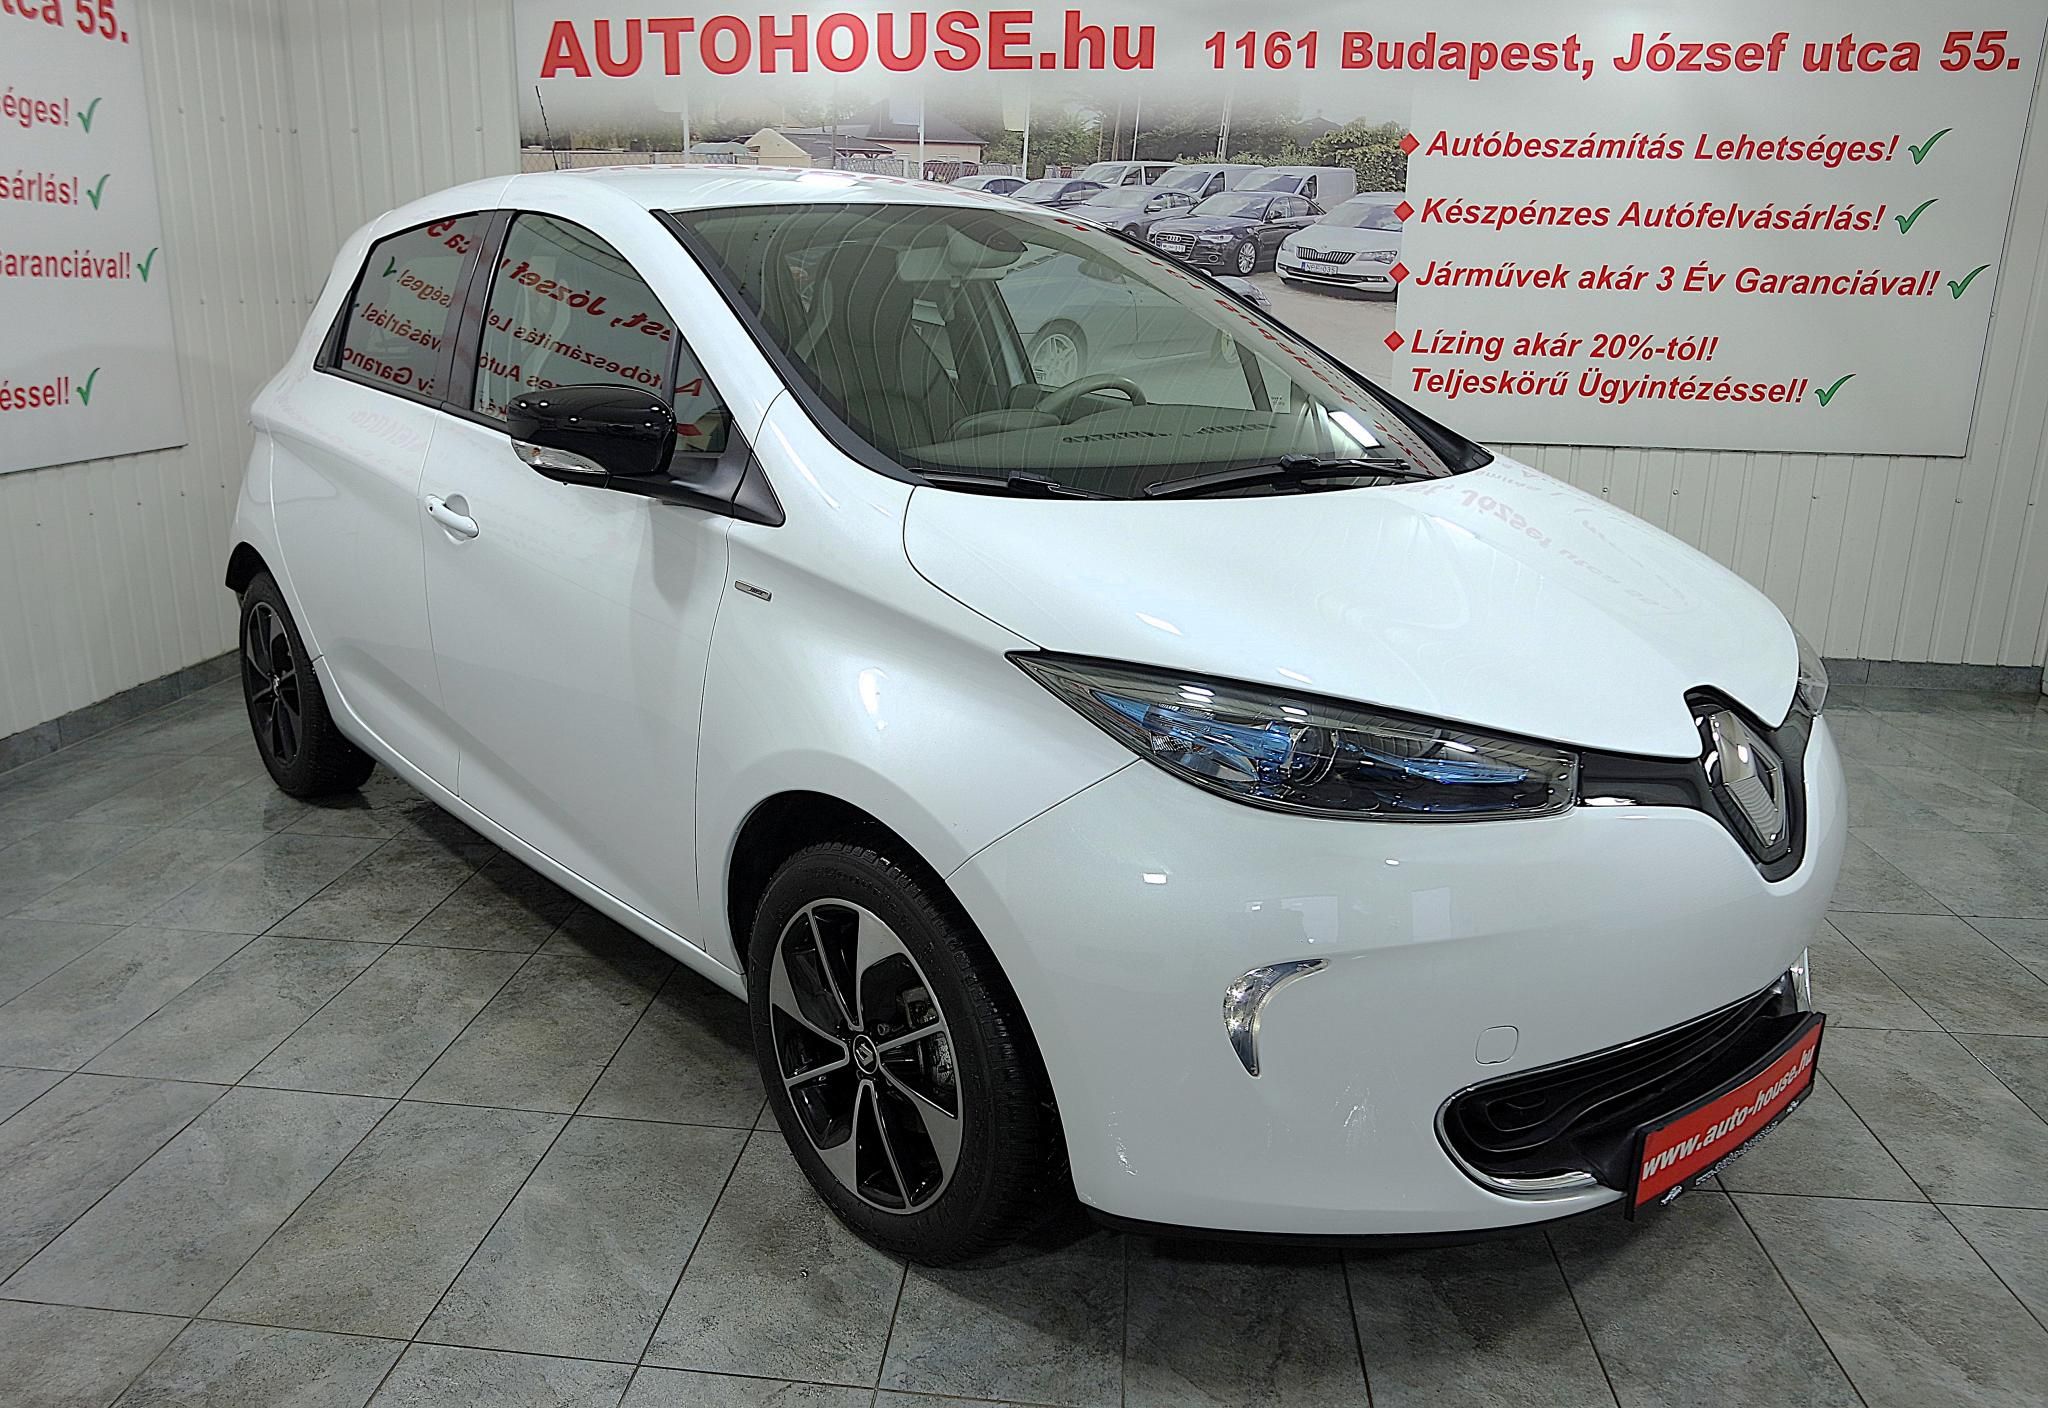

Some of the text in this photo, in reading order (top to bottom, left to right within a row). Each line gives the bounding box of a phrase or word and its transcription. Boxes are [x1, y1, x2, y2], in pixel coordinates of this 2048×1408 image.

[75, 0, 129, 43] 55.
[540, 10, 1156, 79] AUTOHOUSE.hu
[1205, 30, 2020, 81] 1161 Budapest, József utca 55.
[0, 86, 69, 129] éges!
[1426, 131, 1900, 168] Autóbeszámítás Lehetséges!
[1422, 198, 1887, 231] Készpénzes Autófelvásárlás!
[0, 250, 130, 280] aranciával!
[1416, 260, 1941, 296] Járművek akár 3 Év Garanciával!
[1412, 330, 1719, 361] Lízing akár 20%-tól!
[1413, 367, 1808, 405] Teljeskörű Ügyintézéssel!
[1642, 1045, 1816, 1181] www.auto-house.hu
